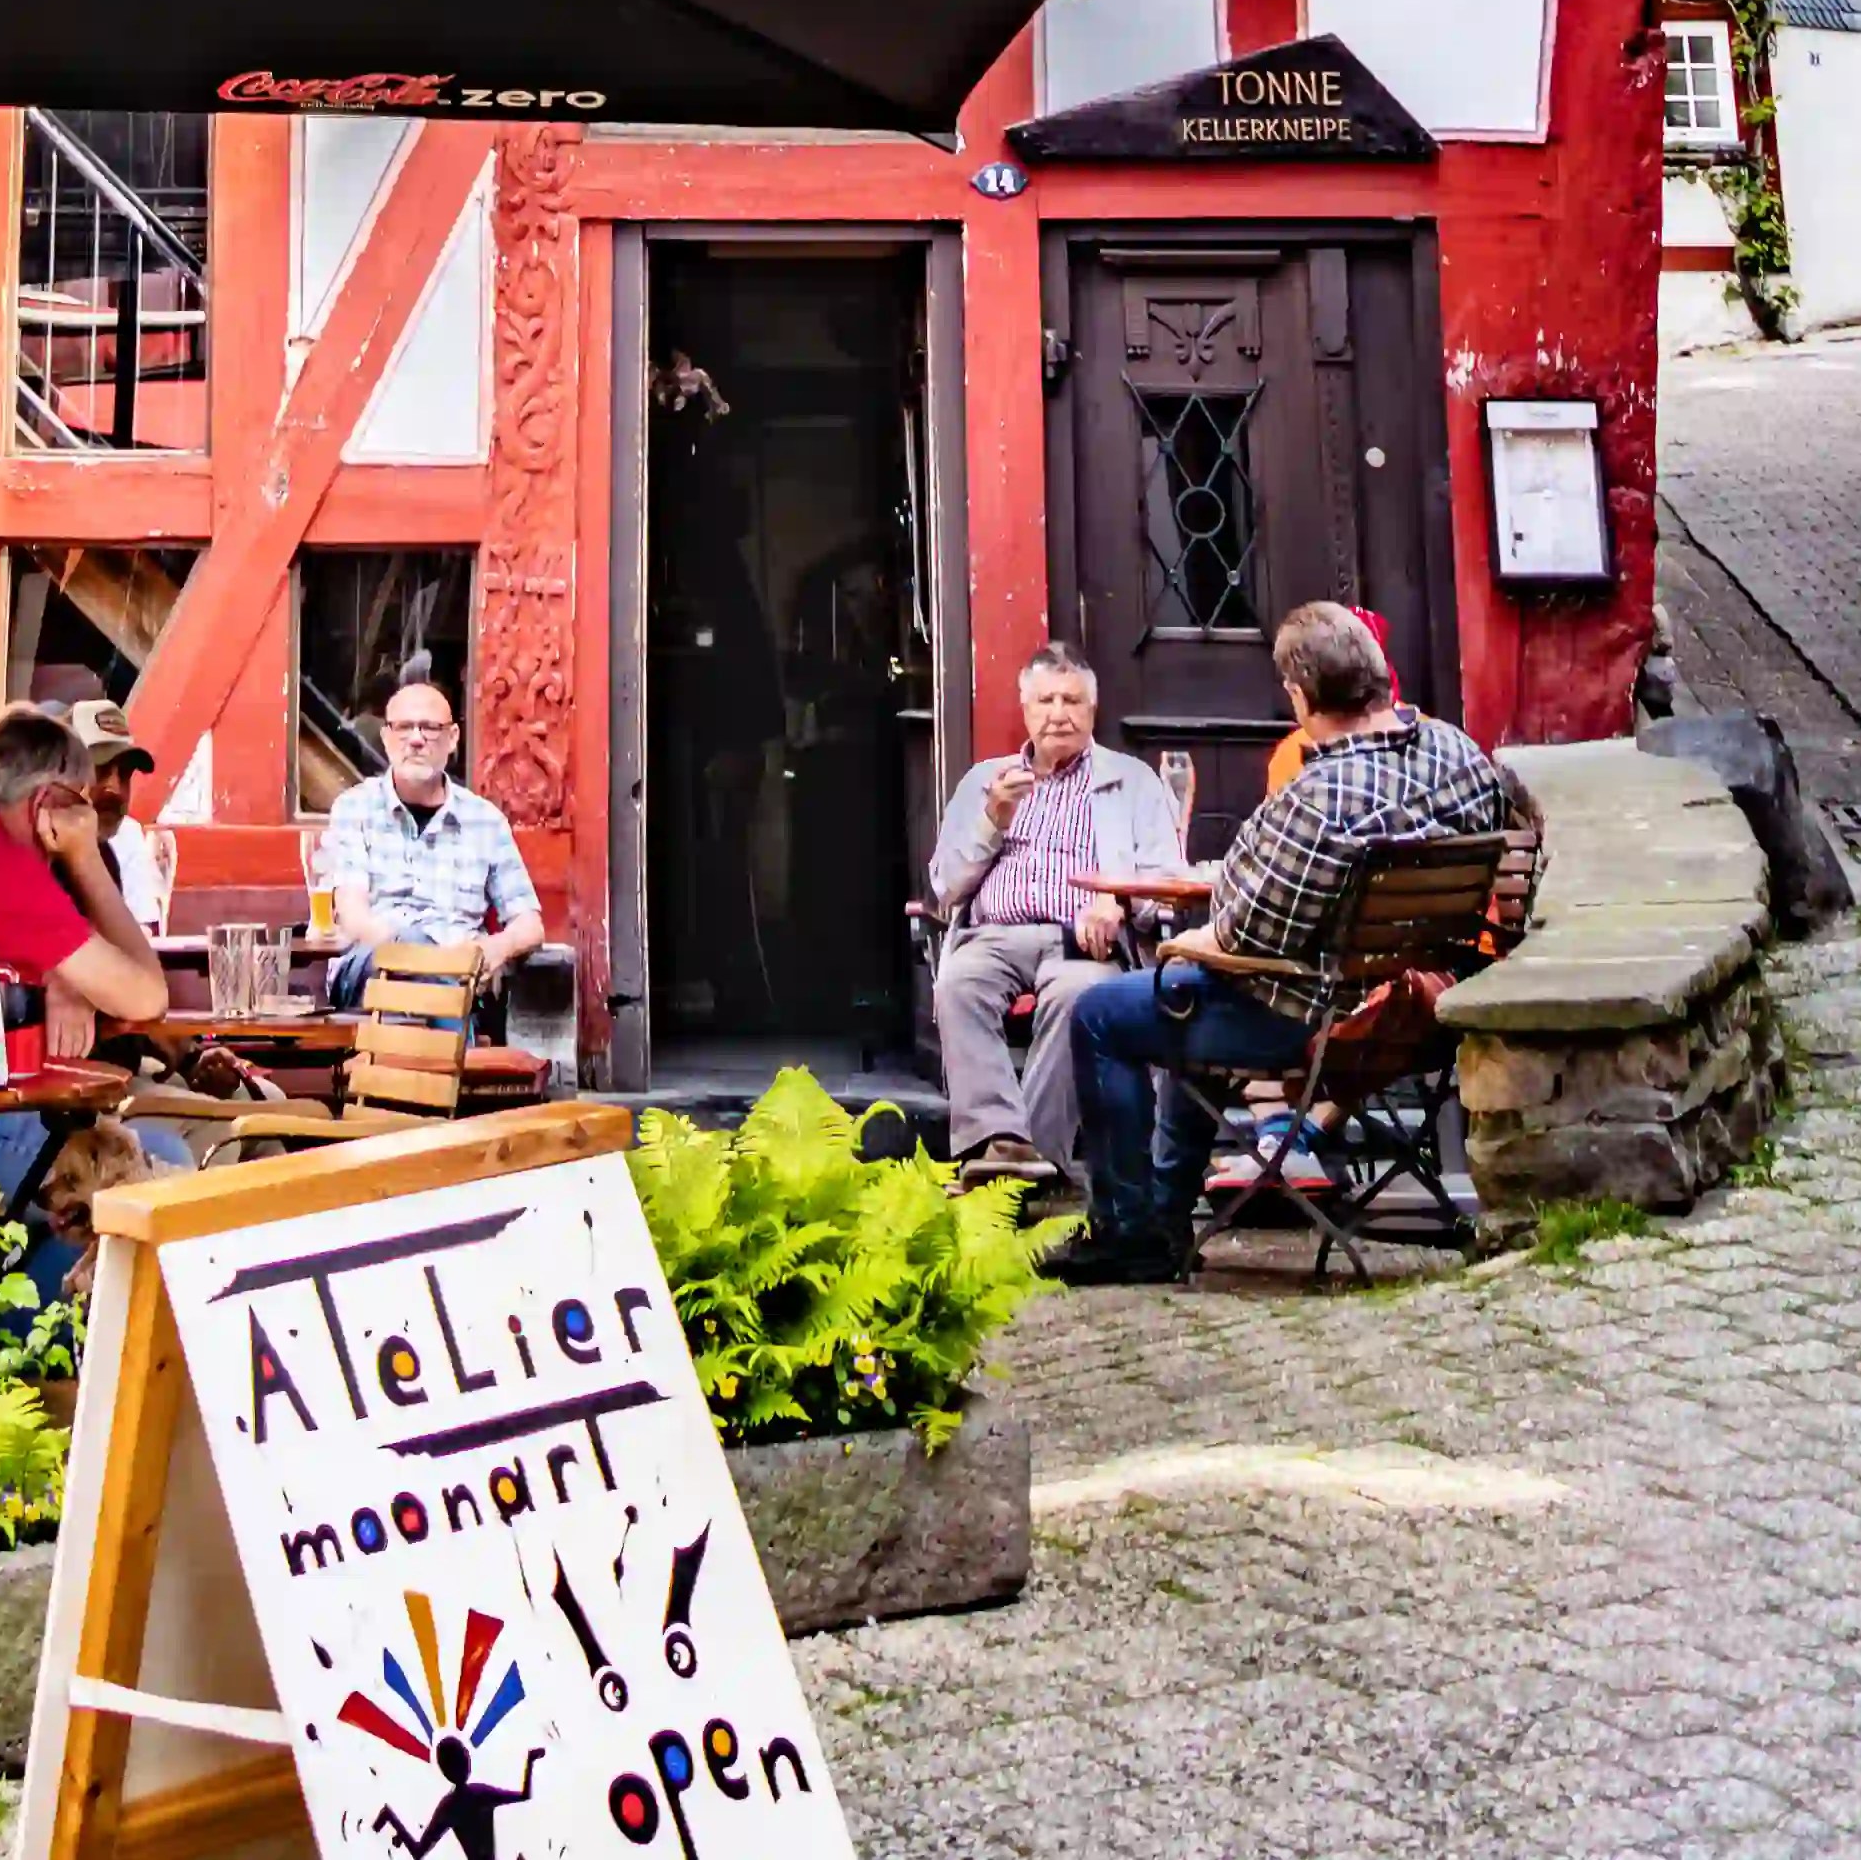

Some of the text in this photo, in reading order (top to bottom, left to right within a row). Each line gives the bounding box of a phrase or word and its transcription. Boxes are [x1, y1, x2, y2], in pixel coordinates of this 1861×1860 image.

[460, 88, 608, 109] zero
[1217, 70, 1343, 107] TONNE
[1181, 117, 1353, 142] KELLERKNEIPE
[982, 168, 1016, 193] 14
[608, 1717, 813, 1860] open
